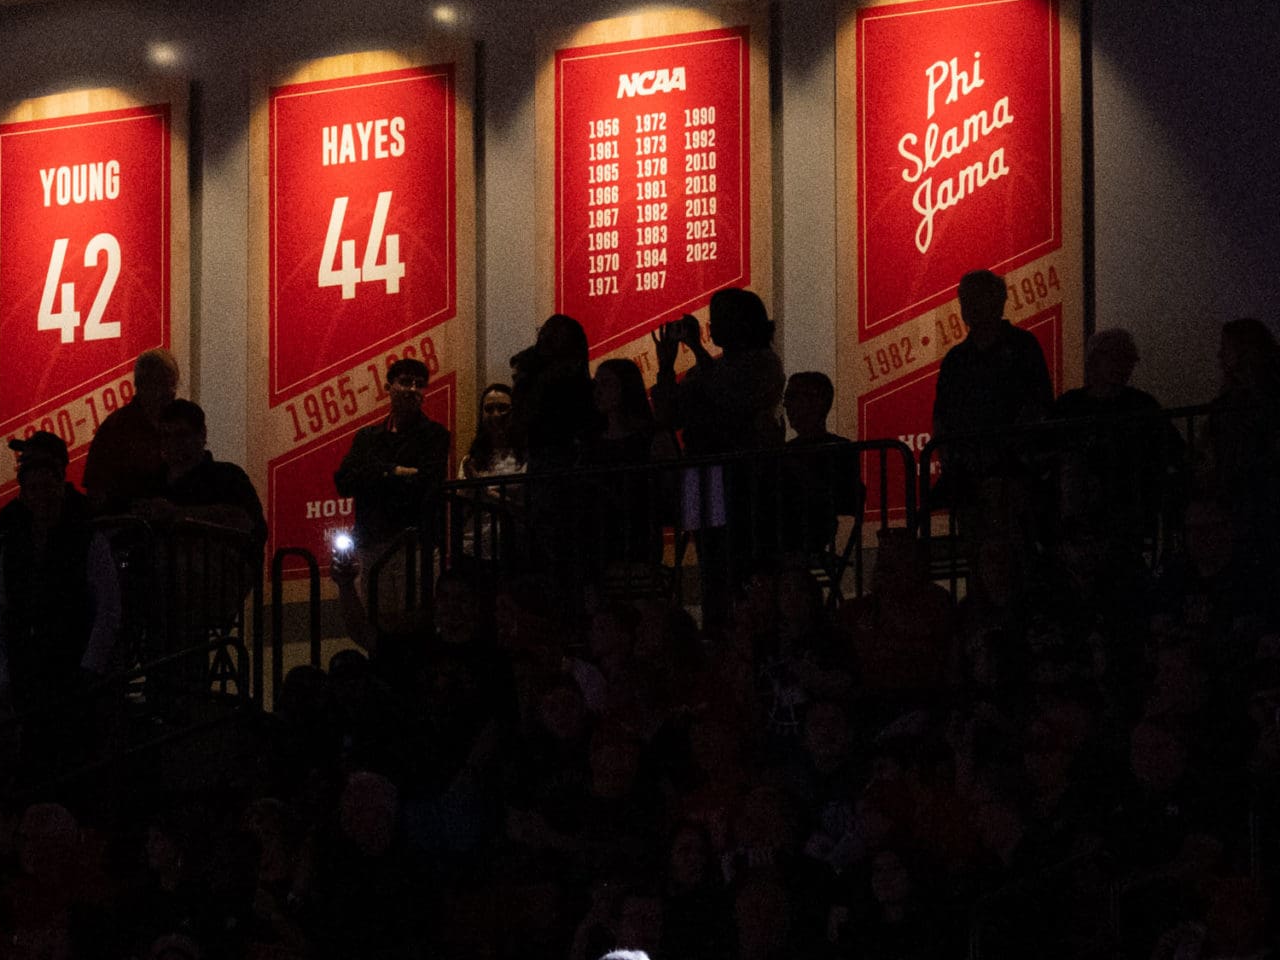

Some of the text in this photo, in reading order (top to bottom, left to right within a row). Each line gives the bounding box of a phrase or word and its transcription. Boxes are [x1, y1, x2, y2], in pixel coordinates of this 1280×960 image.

[616, 66, 687, 99] NCAA
[926, 51, 986, 120] Phi
[588, 106, 717, 139] 1956 1972 1990
[322, 116, 406, 166] HAYES
[588, 129, 717, 162] 1961 1973 1992
[898, 95, 1014, 184] Slama
[39, 159, 120, 207] YOUNG
[588, 151, 717, 184] 1965 1978 2010
[588, 174, 717, 207] 1966 1981 2018
[912, 147, 1010, 254] Jama
[588, 196, 717, 229] 1967 1982 2019
[317, 190, 406, 300] 44
[588, 219, 717, 252] 1968 1983 2021
[588, 242, 717, 275] 1970 1984 2022
[37, 232, 122, 344] 42
[588, 271, 667, 297] 1971 1987
[863, 337, 916, 381] 1982
[1008, 265, 1061, 311] 1984
